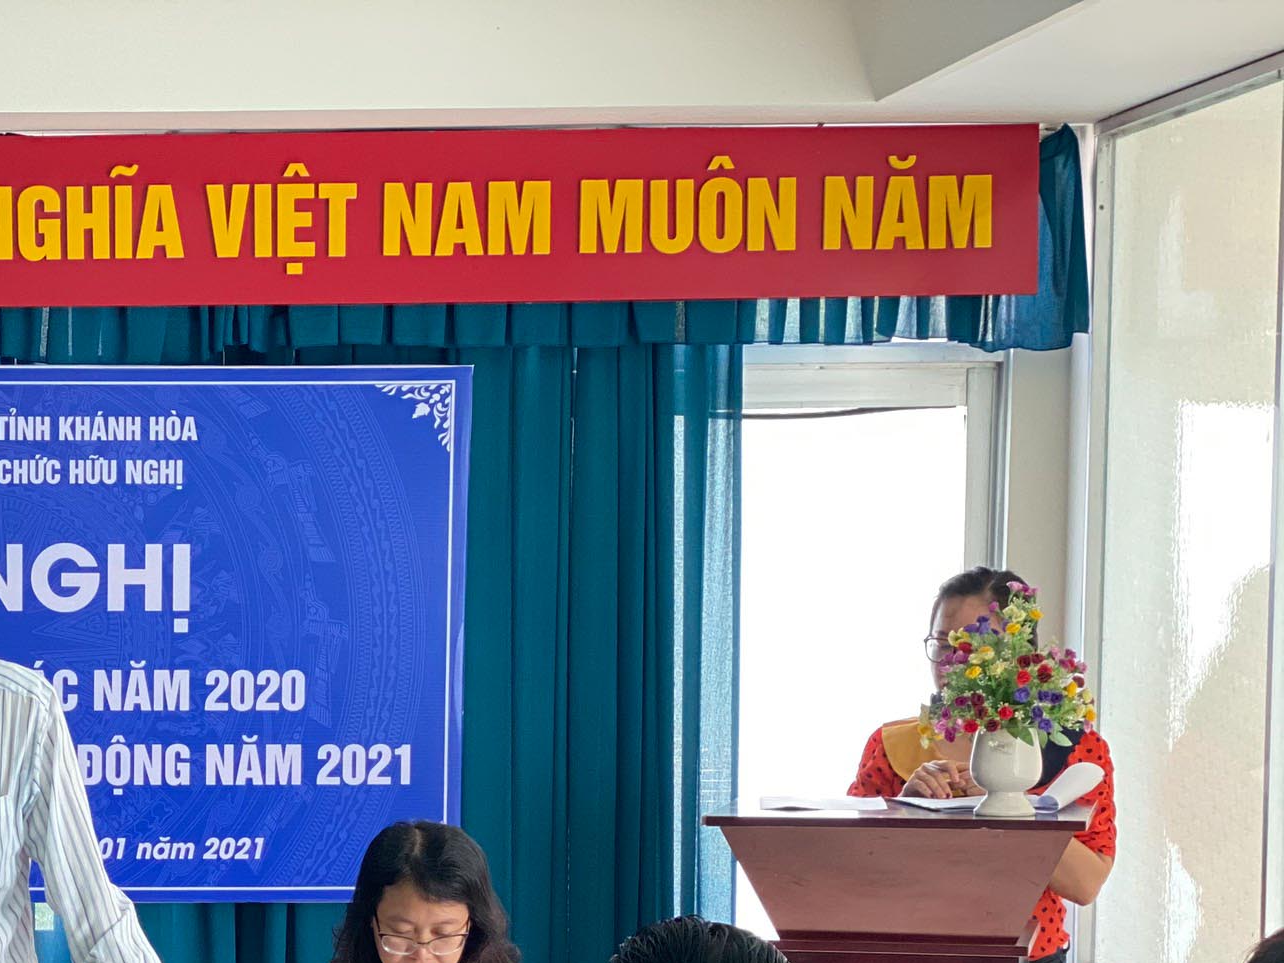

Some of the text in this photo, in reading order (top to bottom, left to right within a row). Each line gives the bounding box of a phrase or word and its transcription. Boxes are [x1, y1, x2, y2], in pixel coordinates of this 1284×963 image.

[207, 163, 357, 274] VIỆT
[384, 181, 550, 256] NAM
[580, 156, 796, 253] MUÔN
[824, 155, 991, 249] NĂM
[59, 411, 141, 440] KHÁNH
[150, 410, 197, 441] HÒA
[70, 455, 116, 484] HỮU
[126, 460, 182, 489] NGHỊ
[94, 661, 189, 711] NĂM
[205, 669, 305, 712] 2020
[77, 735, 190, 795] ĐỘNG
[206, 735, 301, 785] NĂM
[317, 744, 410, 785] 2021
[137, 837, 194, 860] năm
[203, 837, 265, 860] 2021
